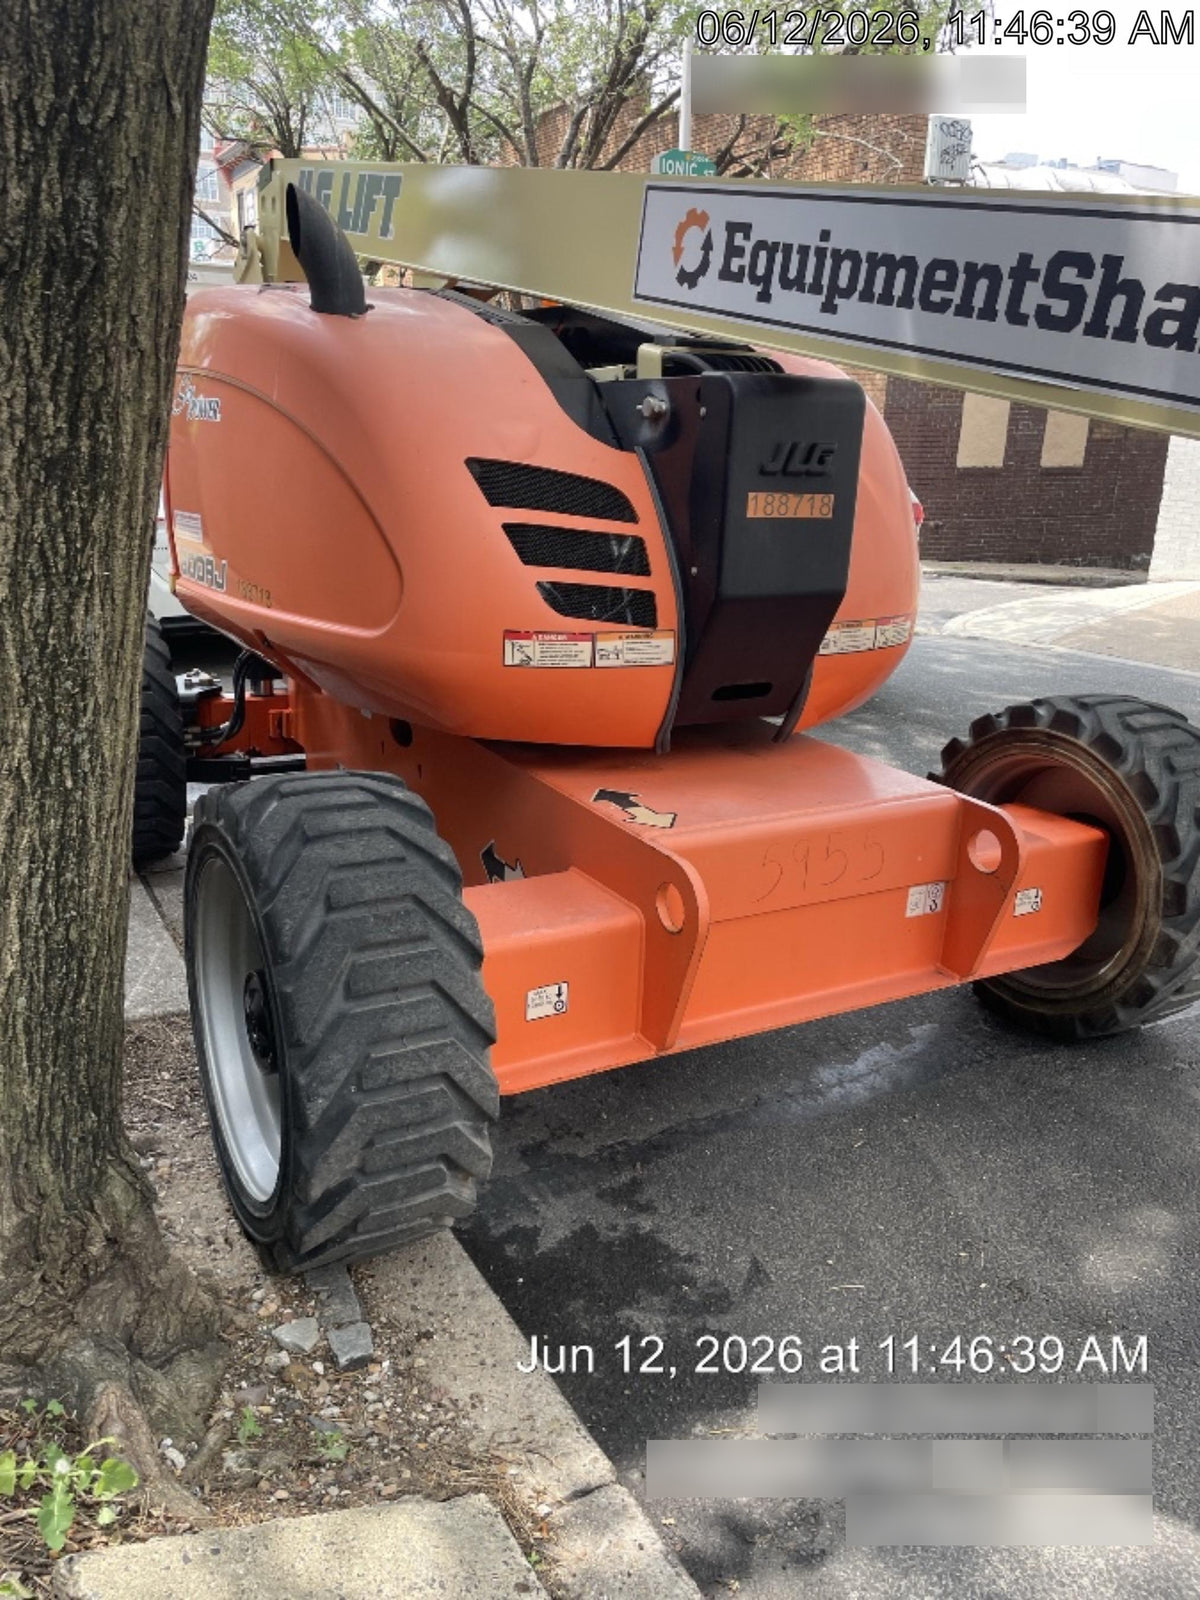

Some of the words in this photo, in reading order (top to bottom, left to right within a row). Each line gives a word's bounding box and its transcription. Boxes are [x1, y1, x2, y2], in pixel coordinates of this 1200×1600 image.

[661, 157, 698, 177] IONIC
[337, 170, 403, 239] LIFT
[717, 219, 1200, 354] EquipmentSha
[758, 440, 838, 478] JLG
[750, 494, 833, 517] 188718
